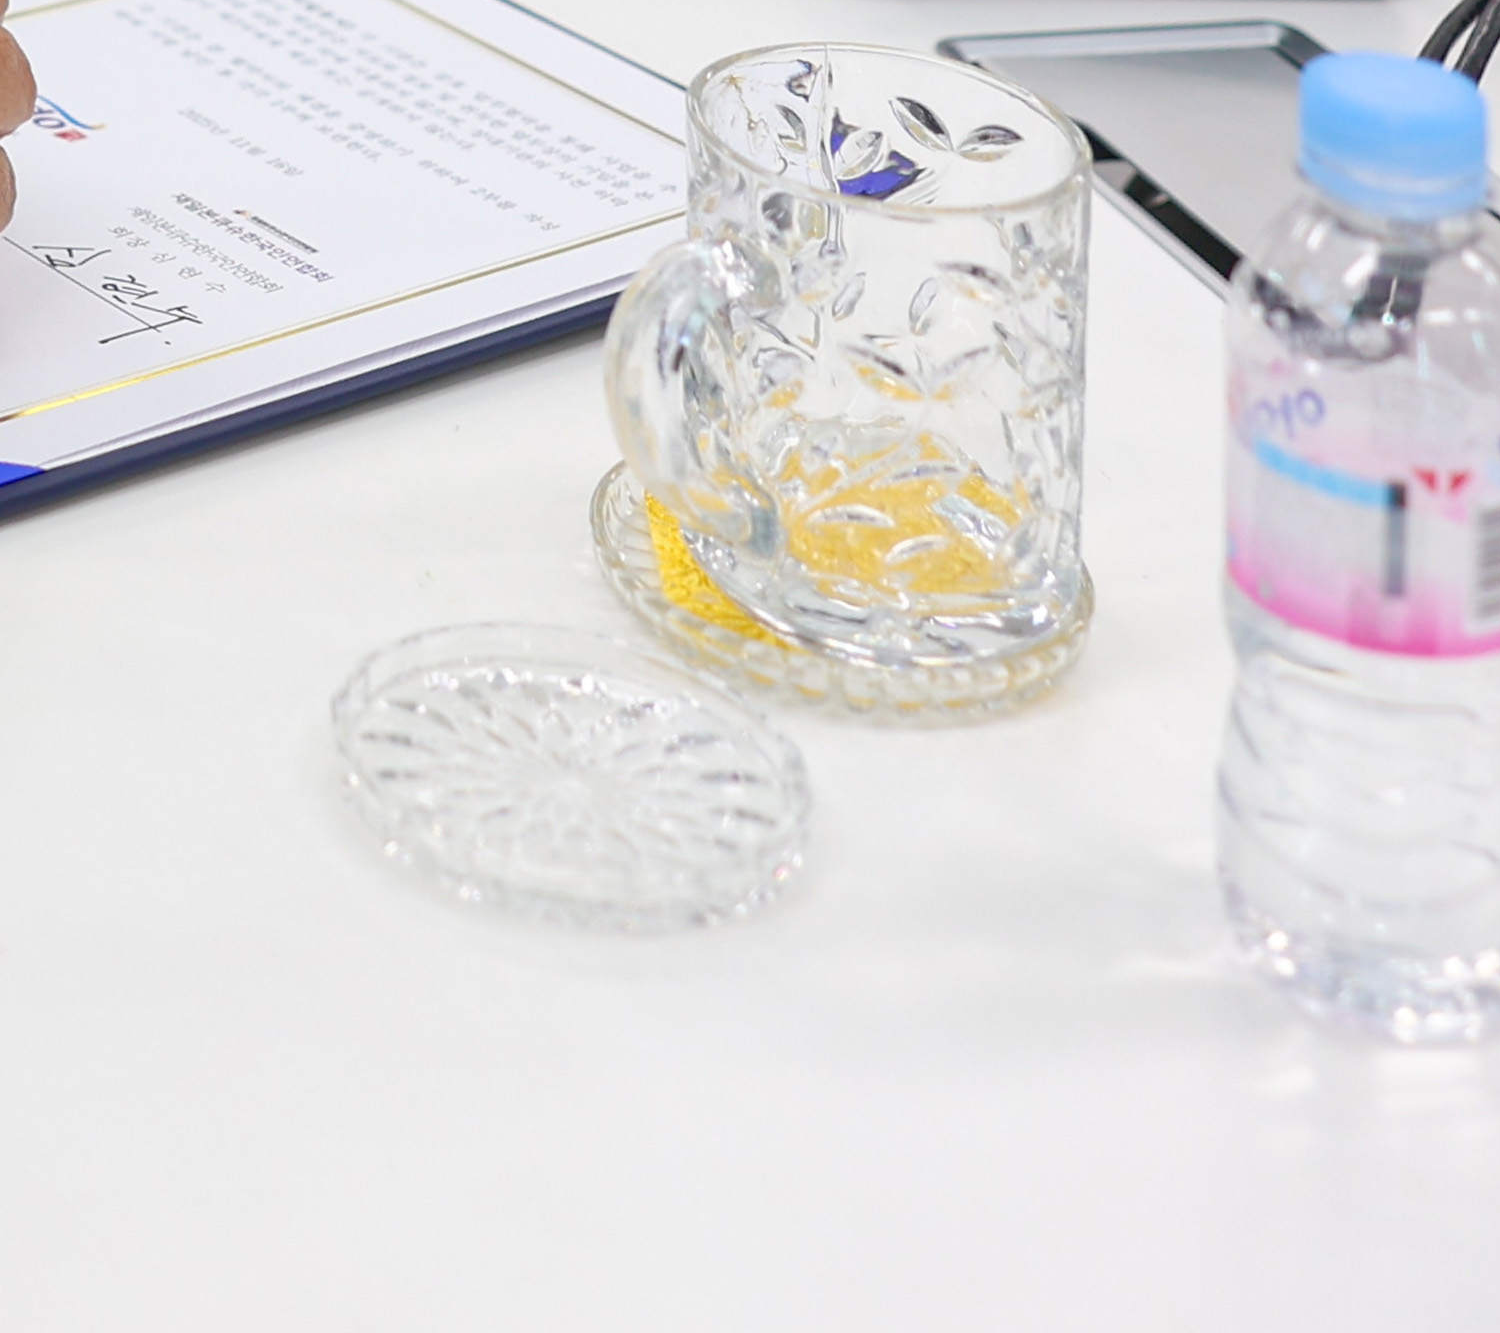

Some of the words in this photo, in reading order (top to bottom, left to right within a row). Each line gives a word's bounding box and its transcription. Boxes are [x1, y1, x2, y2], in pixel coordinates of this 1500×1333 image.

[106, 225, 152, 249] 회장
[126, 205, 286, 295] 재일본큐슈한국인연합회
[171, 192, 336, 284] 재일본큐슈한국인연합회
